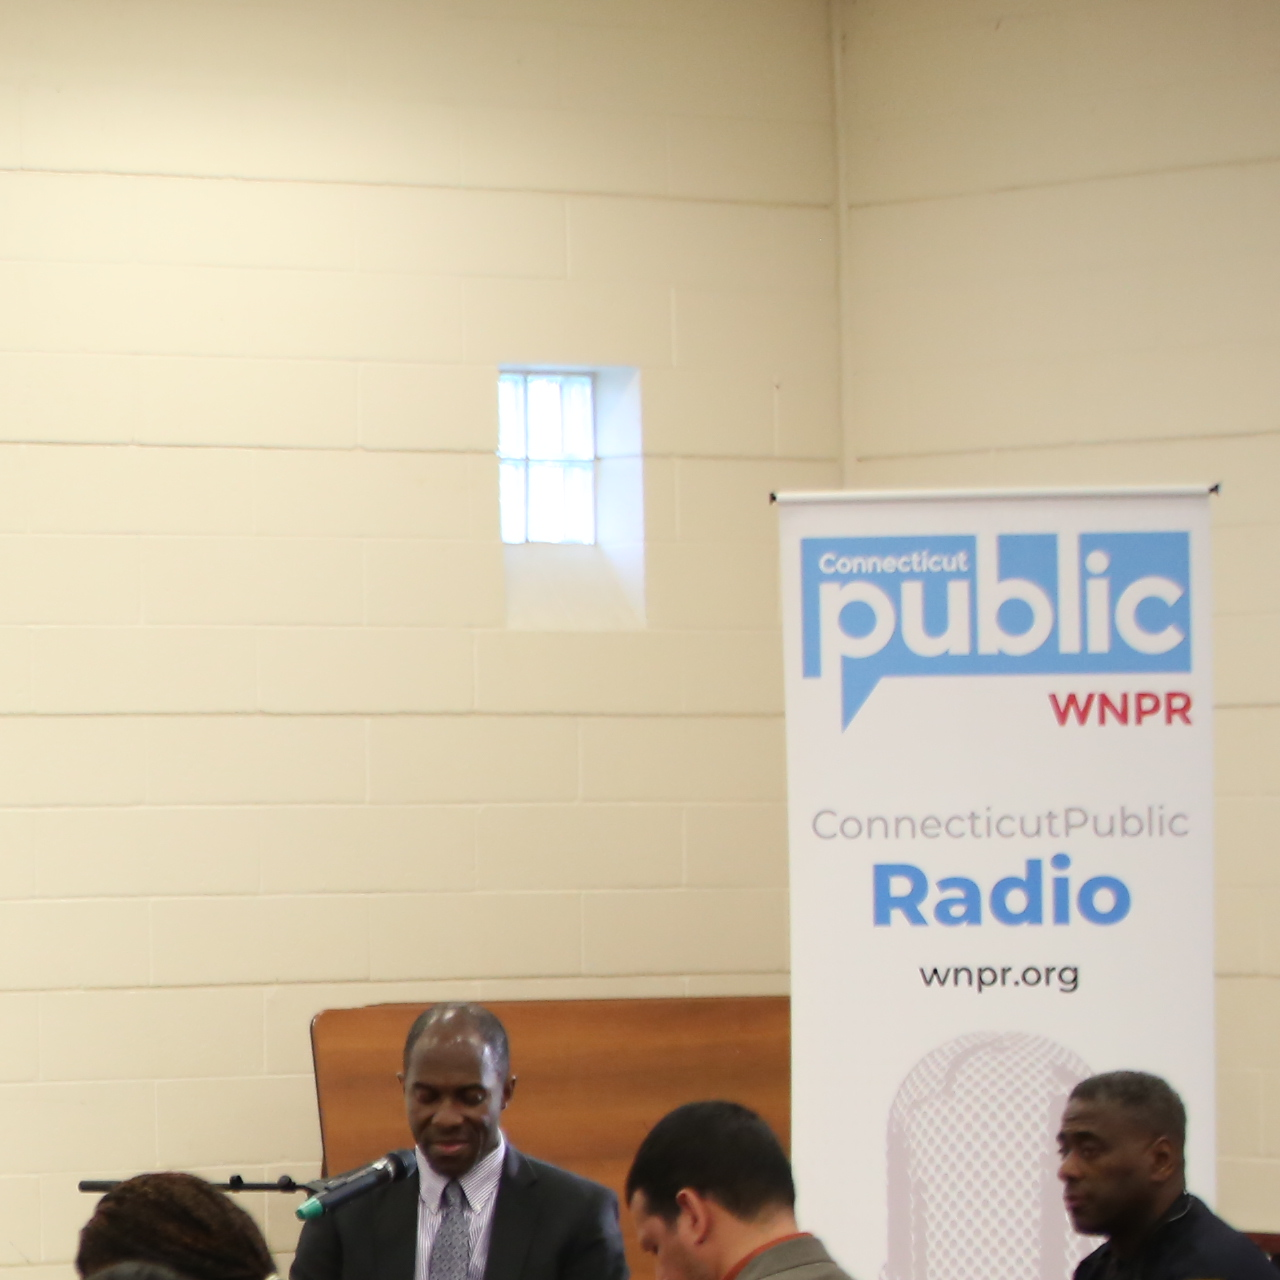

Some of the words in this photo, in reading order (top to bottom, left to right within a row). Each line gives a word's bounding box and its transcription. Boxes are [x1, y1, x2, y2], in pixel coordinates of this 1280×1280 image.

[818, 550, 969, 574] Connecticut
[819, 533, 1186, 678] public
[1048, 692, 1193, 727] WNPR
[811, 805, 1191, 841] ConnecticutPublic
[872, 852, 1132, 928] Radio
[919, 962, 1080, 993] wnpr.org
